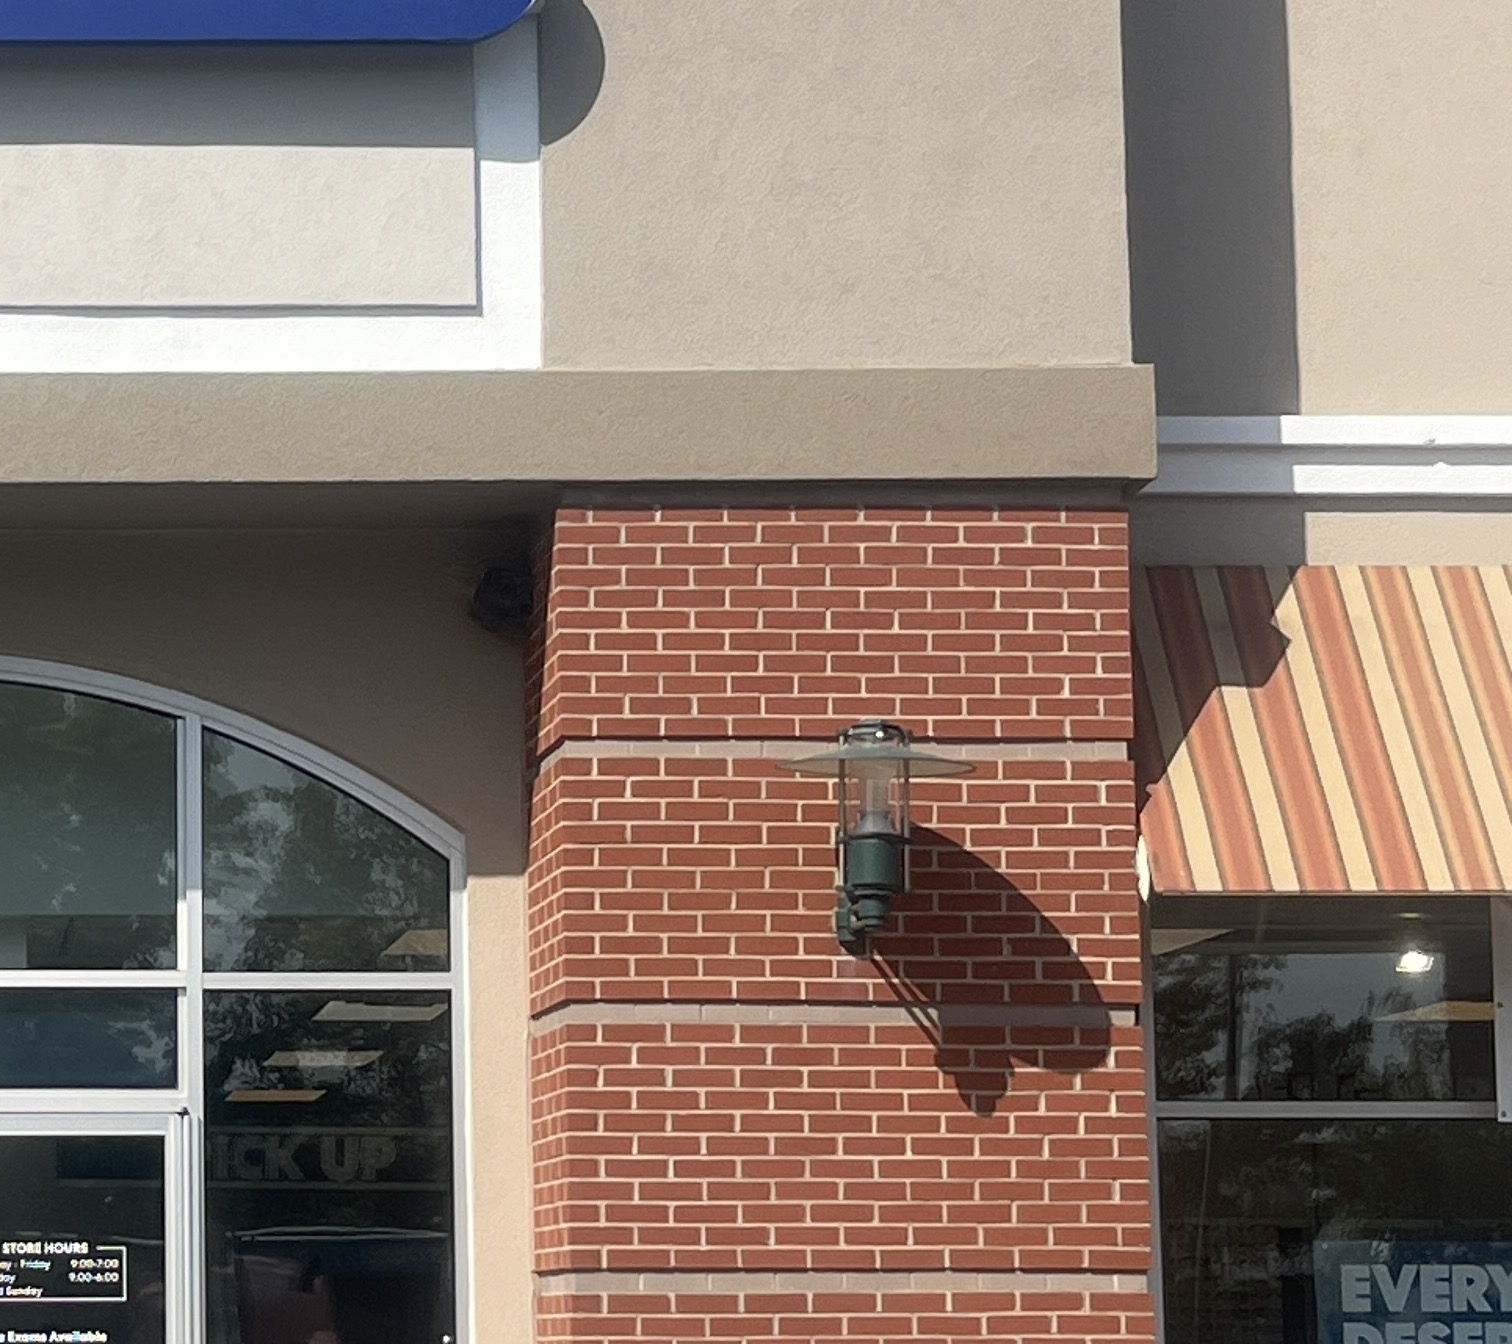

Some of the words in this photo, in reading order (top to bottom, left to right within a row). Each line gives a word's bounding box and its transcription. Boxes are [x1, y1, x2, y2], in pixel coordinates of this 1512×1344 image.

[2, 1242, 41, 1254] STORE
[44, 1242, 88, 1254] HOURS
[20, 1259, 51, 1271] Friday
[6, 1286, 43, 1297] Sunday
[8, 1331, 47, 1343] Exams
[49, 1331, 107, 1343] Available
